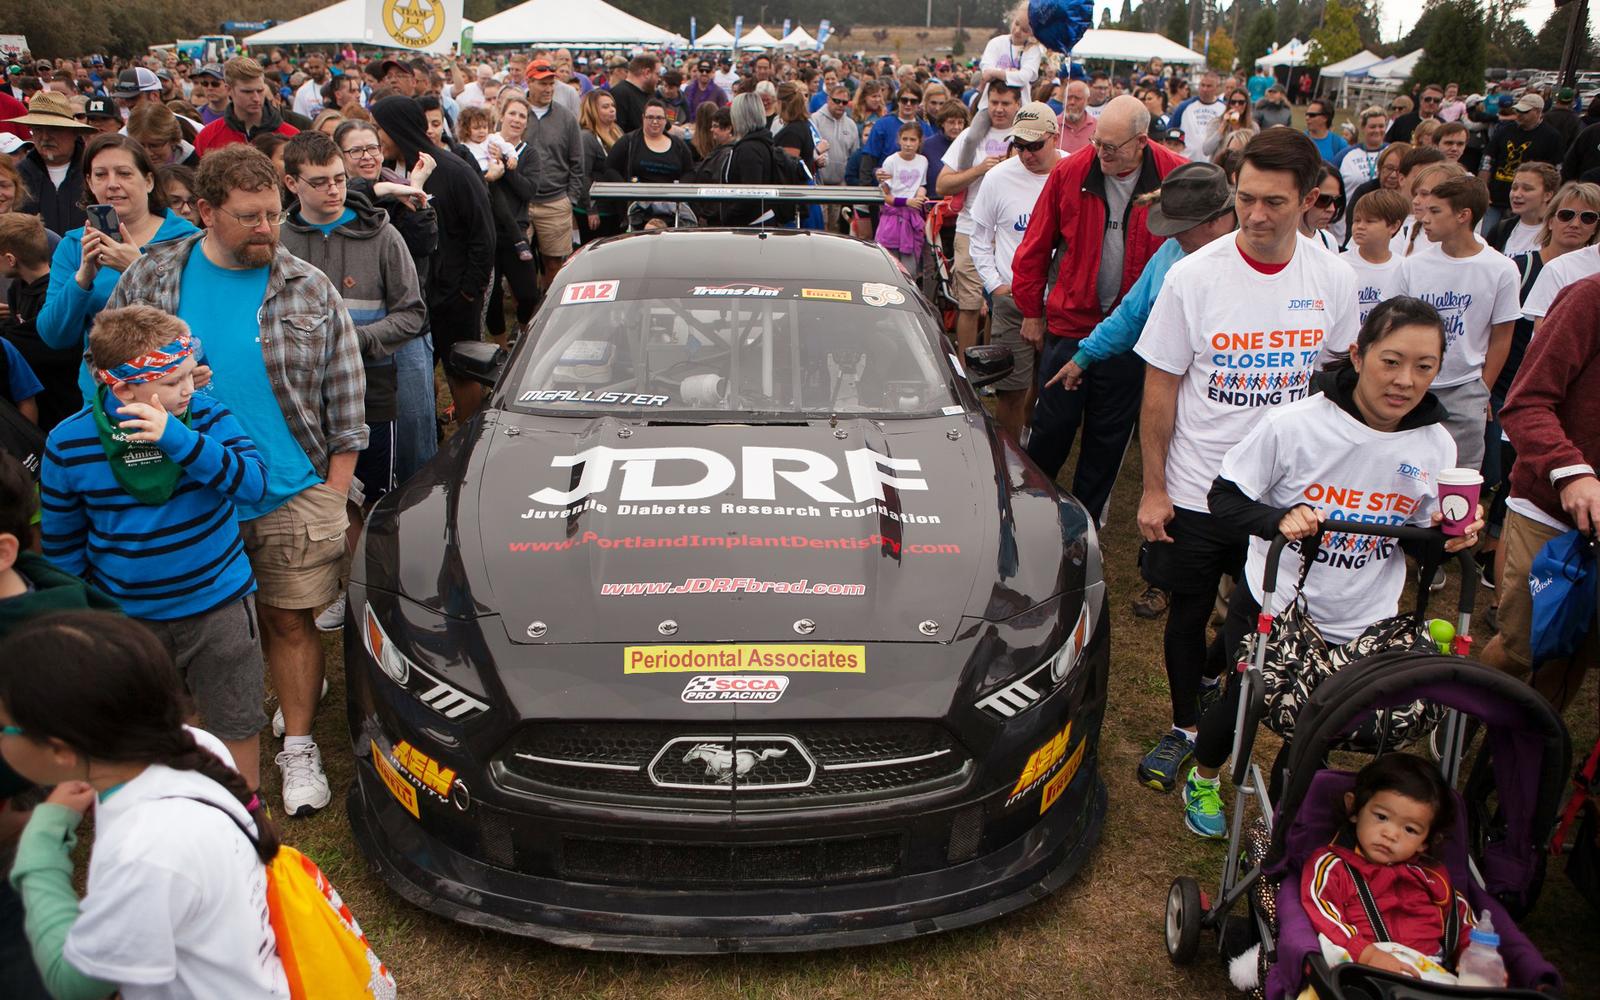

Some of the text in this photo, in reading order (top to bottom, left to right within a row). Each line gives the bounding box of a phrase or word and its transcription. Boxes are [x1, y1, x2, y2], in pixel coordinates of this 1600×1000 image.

[401, 8, 427, 17] TEAM
[571, 284, 612, 300] TA2
[692, 286, 780, 297] Trans Am
[1211, 329, 1324, 351] ONE STEP
[1212, 352, 1295, 369] CLOSER
[1207, 386, 1282, 407] ENDING
[123, 450, 161, 462] Amica
[528, 446, 928, 506] JDRF
[1303, 483, 1364, 509] ONE
[520, 499, 941, 524] Juvenile Diabetes Research Foundation
[508, 530, 961, 554] www.PortlandImplantDentistry.com
[601, 577, 866, 595] www.JDRFbrad.com
[631, 649, 858, 669] Periodontal Associates
[715, 679, 782, 691] SCCA
[686, 691, 777, 700] PRO RACING
[391, 741, 457, 798] AEM
[1009, 720, 1072, 799] AEM
